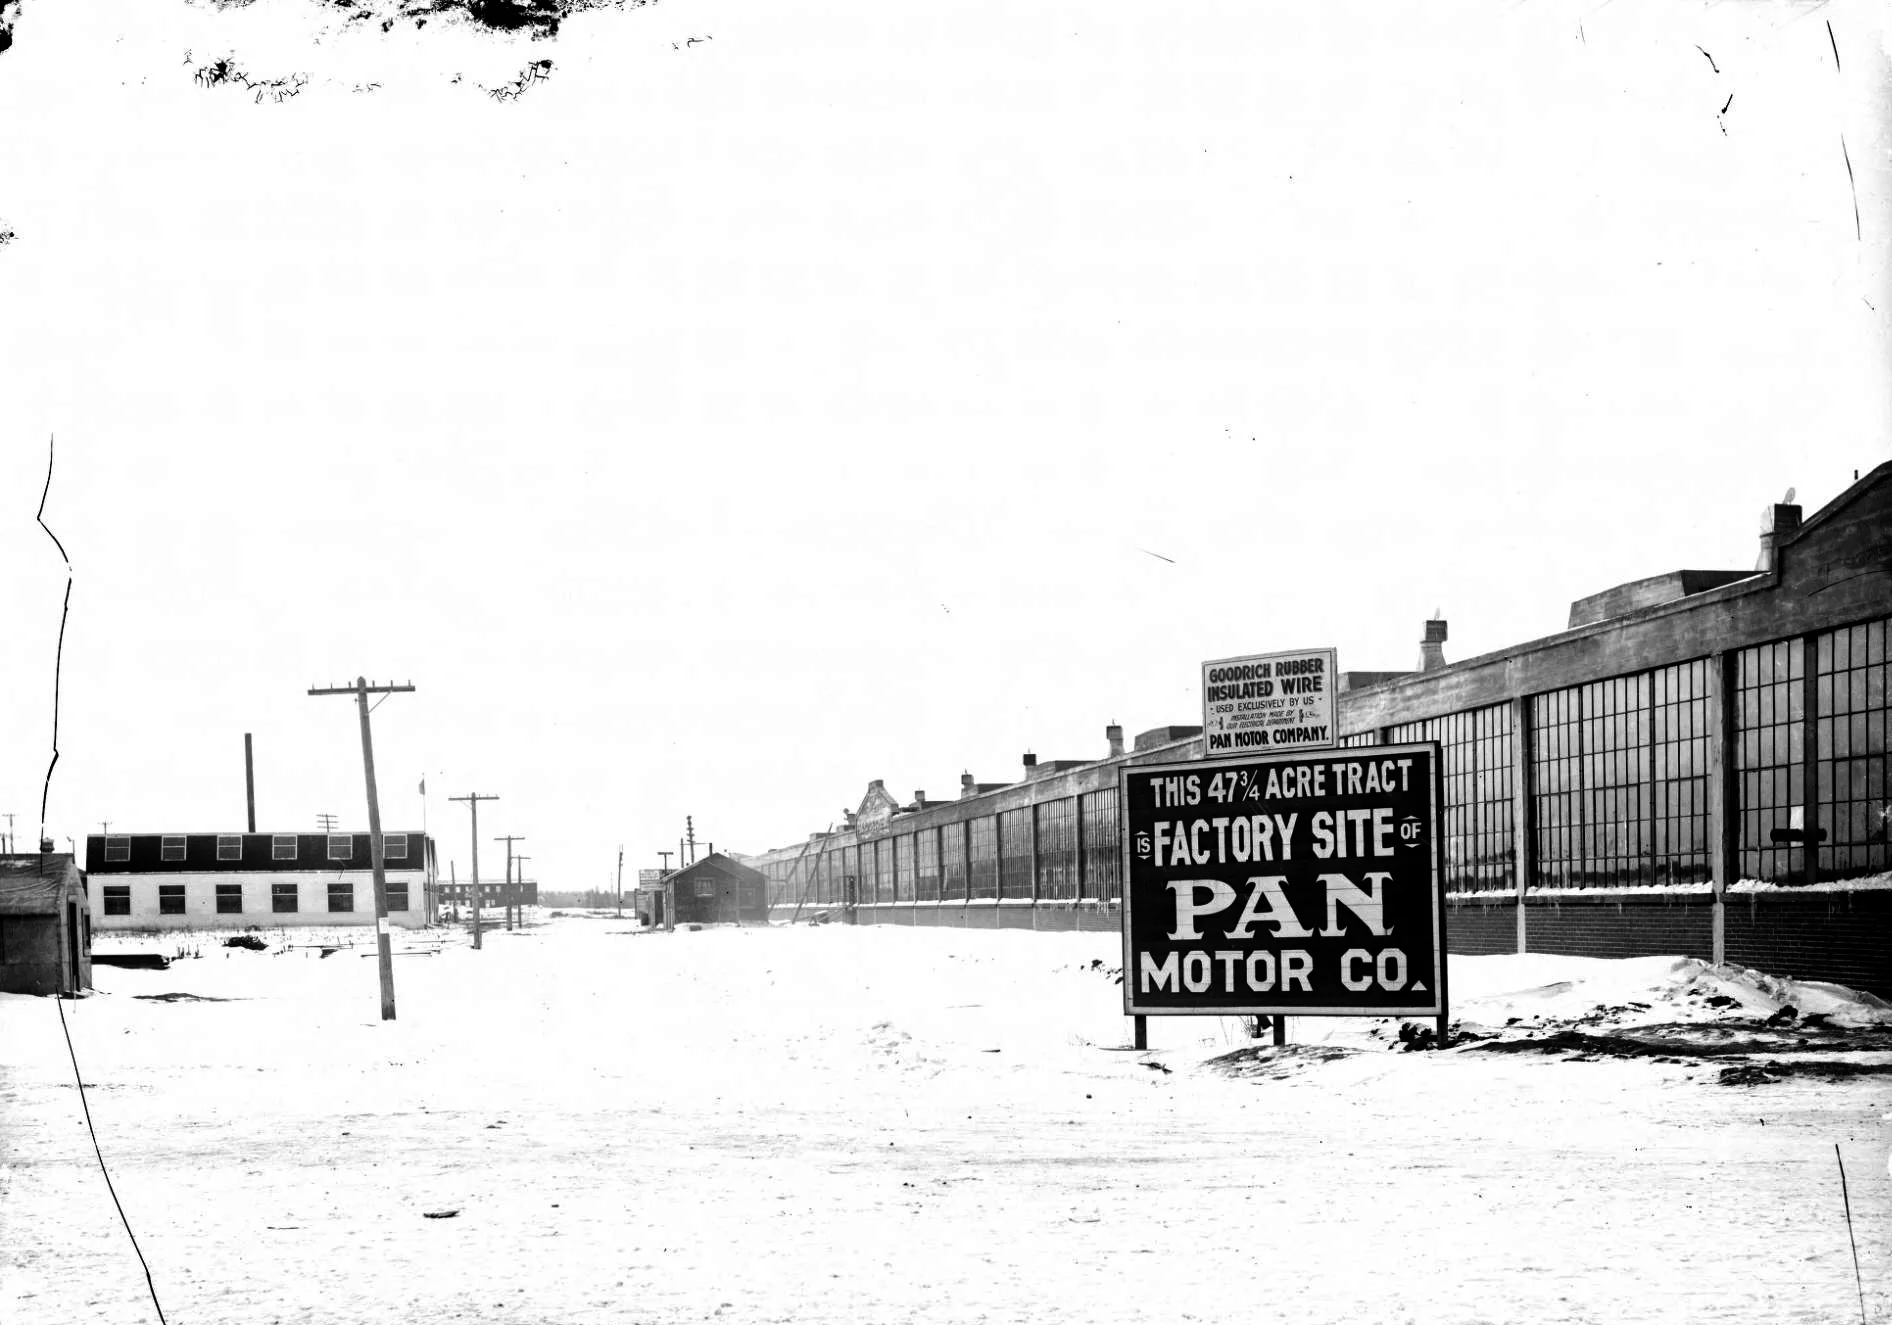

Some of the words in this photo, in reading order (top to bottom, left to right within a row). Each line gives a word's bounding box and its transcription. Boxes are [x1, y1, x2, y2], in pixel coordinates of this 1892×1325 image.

[1210, 663, 1272, 683] GOODRICH
[1275, 658, 1324, 677] RUBBER
[1208, 681, 1273, 702] INSULATED
[1280, 676, 1322, 694] WIRE
[1216, 704, 1234, 713] USED
[1238, 699, 1285, 711] EXCLUSIVELY
[1290, 697, 1299, 706] BY
[1304, 696, 1314, 705] US
[1210, 733, 1231, 749] PAN
[1235, 730, 1269, 747] MOTOR
[1273, 726, 1329, 744] COMPANY.
[1150, 774, 1201, 808] THIS
[1265, 764, 1326, 800] ACRE
[1332, 759, 1413, 795] TRACT
[1137, 837, 1150, 853] IS
[1154, 813, 1298, 866] FACTORY
[1311, 808, 1395, 859] SITE
[1400, 822, 1421, 839] OF
[1165, 872, 1394, 941] PAN
[1140, 949, 1314, 993] MOTOR
